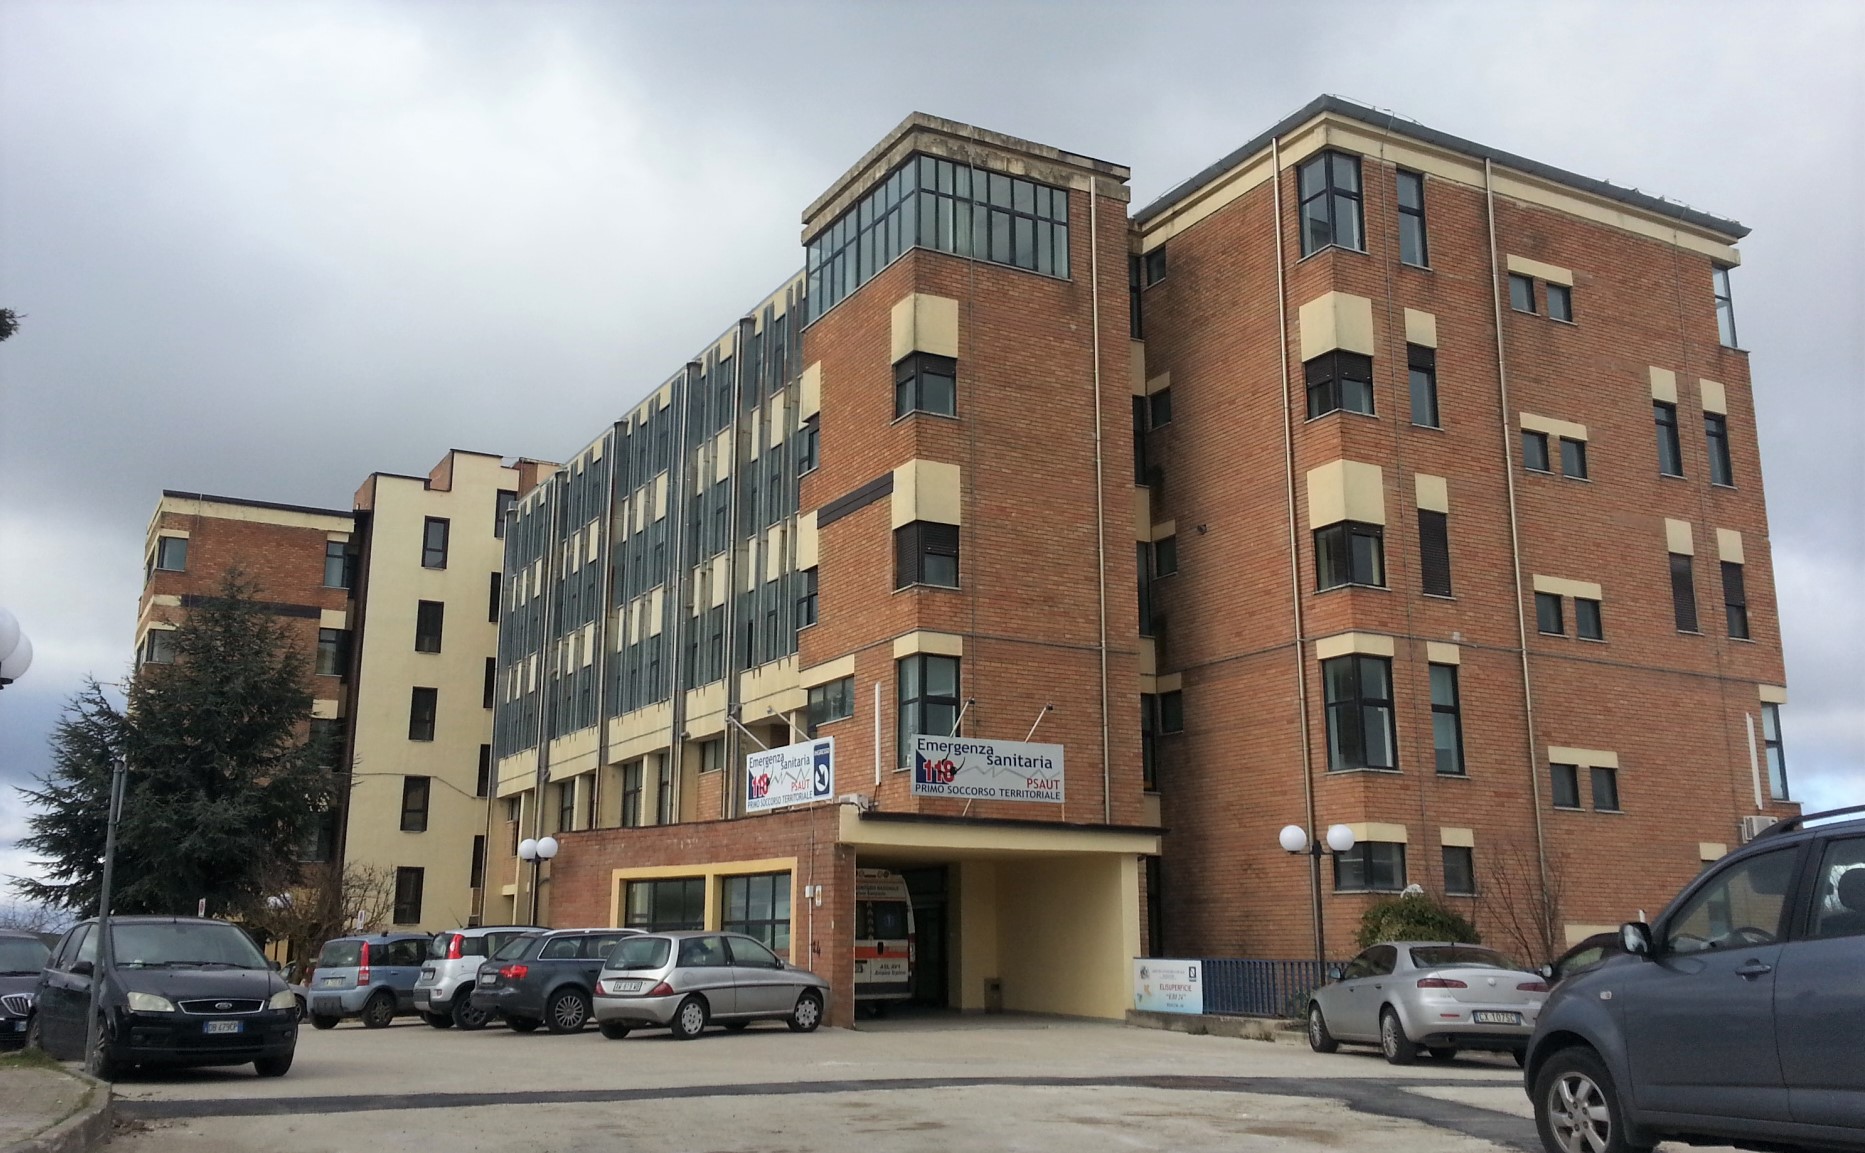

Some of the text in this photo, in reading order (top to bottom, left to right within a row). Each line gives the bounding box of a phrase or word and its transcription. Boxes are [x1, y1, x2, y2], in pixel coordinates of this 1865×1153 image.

[918, 738, 994, 756] Emergenza
[749, 753, 785, 768] Emergenza
[780, 754, 811, 770] sanitaria
[987, 754, 1053, 769] sanitaria
[924, 759, 955, 783] 118
[752, 773, 769, 798] 118
[791, 779, 810, 792] PSAUT
[915, 783, 1061, 800] PRIMO SOCCORSO TERRITORIALE
[1026, 778, 1060, 790] PSAUT
